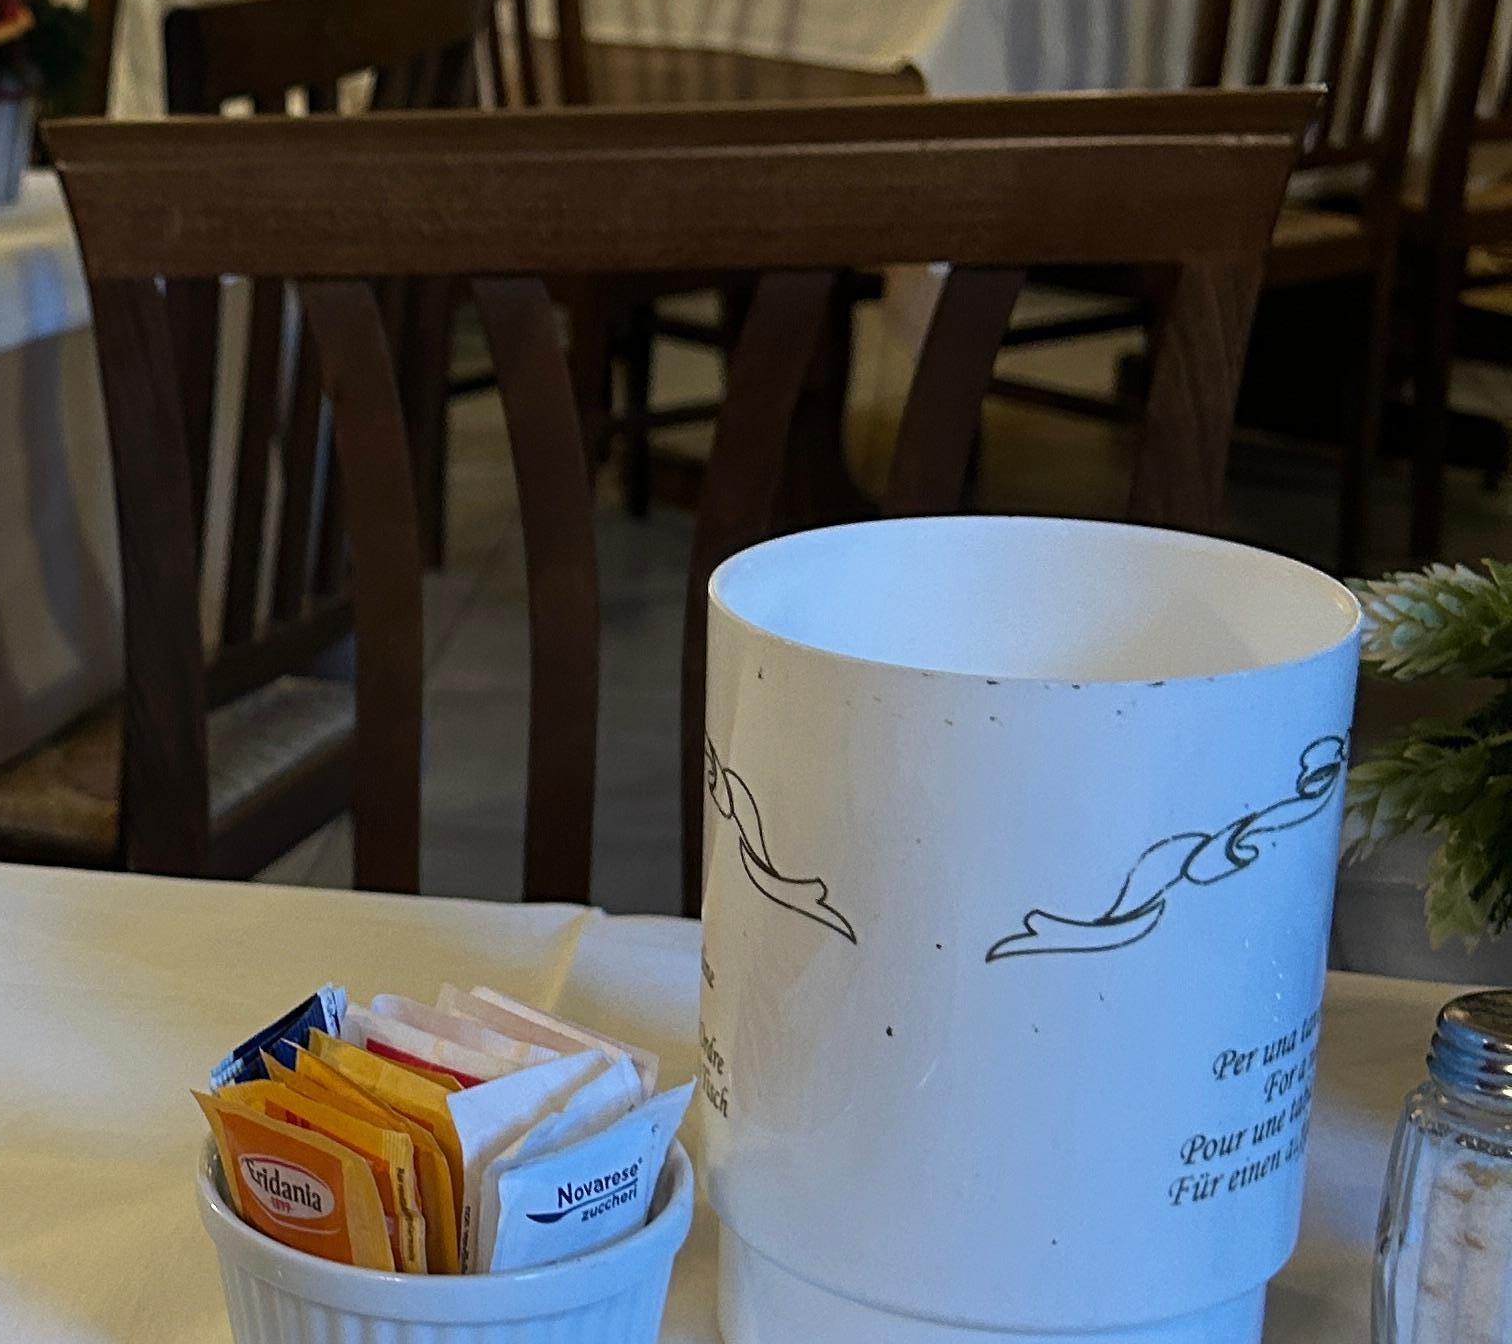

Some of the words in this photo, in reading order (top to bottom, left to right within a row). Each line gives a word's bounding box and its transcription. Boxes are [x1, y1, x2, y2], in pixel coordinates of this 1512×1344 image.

[1212, 1047, 1258, 1081] Per
[1262, 1028, 1297, 1066] una
[1263, 1063, 1297, 1104] For
[1179, 1128, 1248, 1166] Pour
[1252, 1108, 1287, 1145] une
[241, 1157, 322, 1213] Eridania
[557, 1162, 639, 1209] Novarese
[581, 1182, 638, 1223] zuccheri
[1168, 1171, 1225, 1207] Für
[1228, 1150, 1282, 1193] einen
